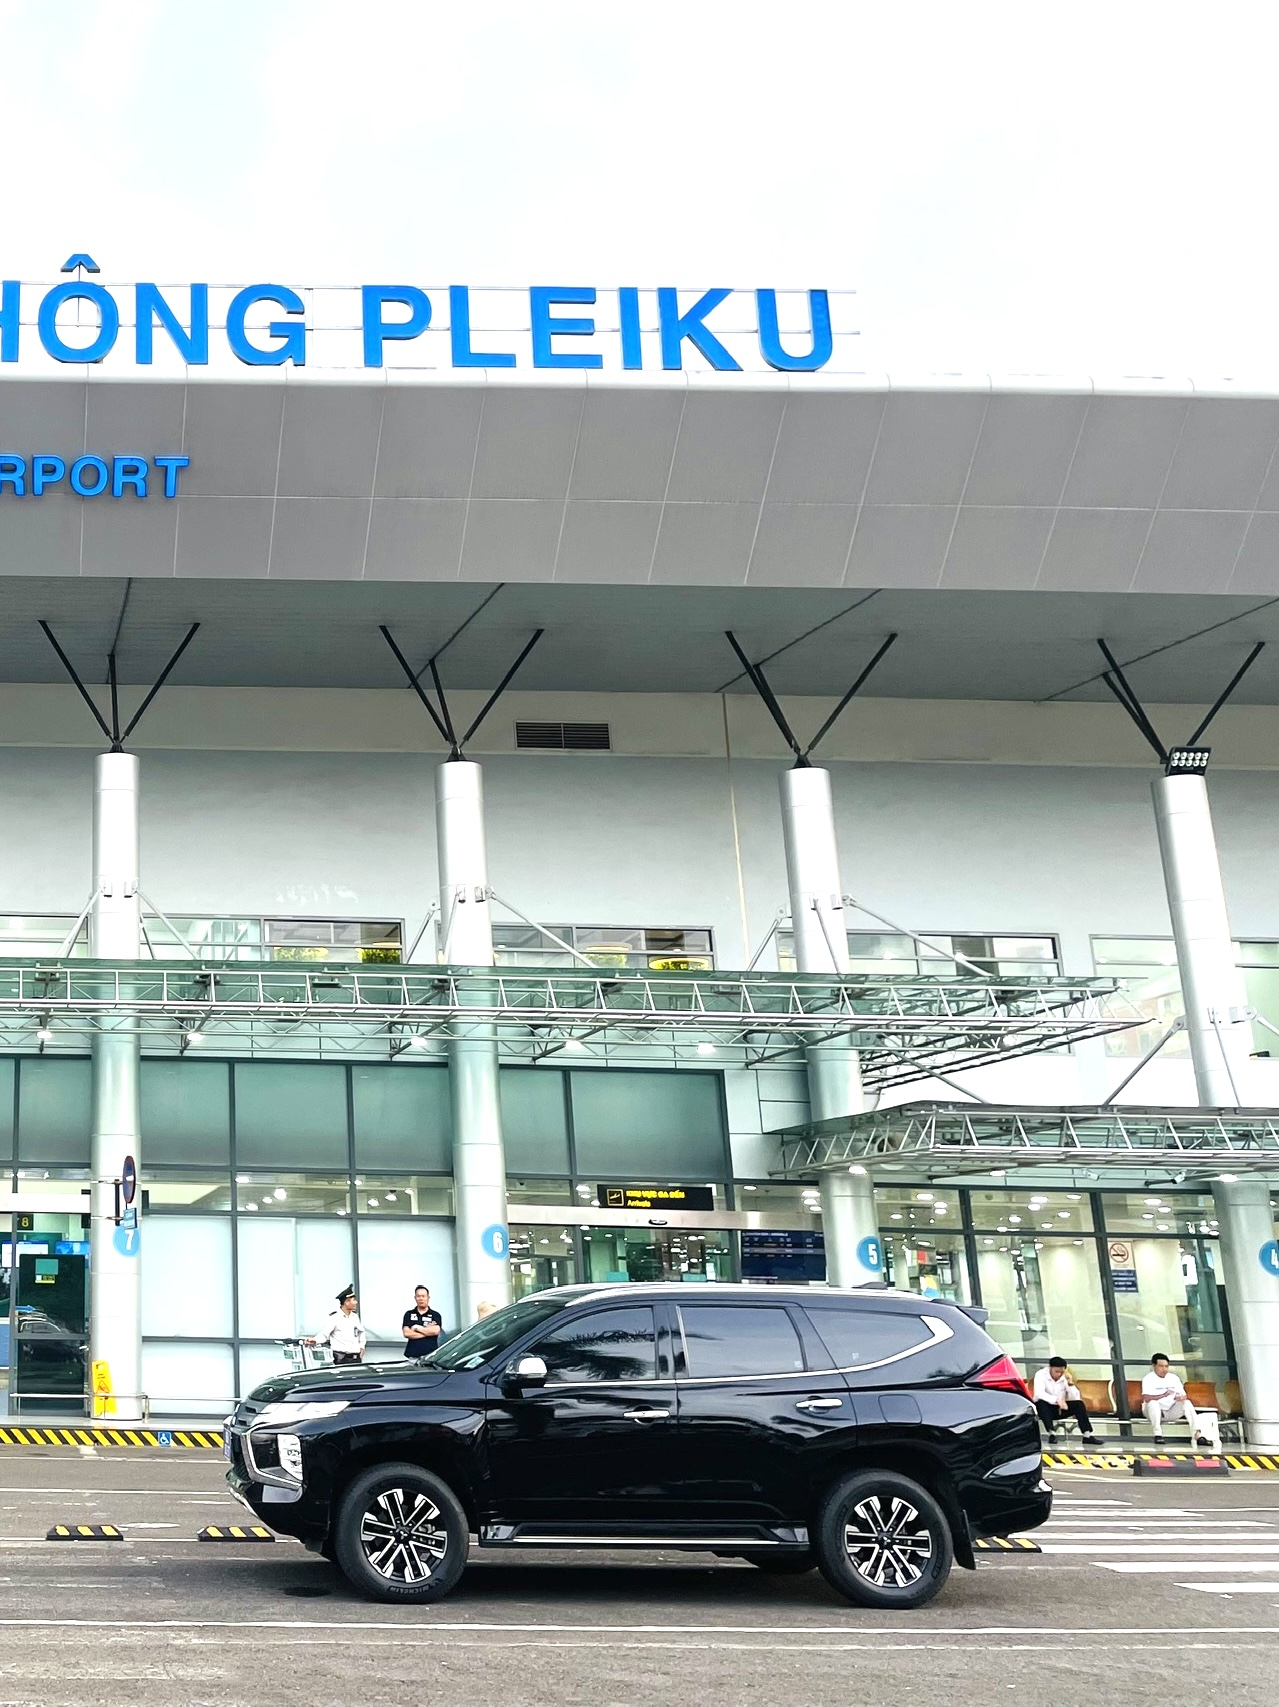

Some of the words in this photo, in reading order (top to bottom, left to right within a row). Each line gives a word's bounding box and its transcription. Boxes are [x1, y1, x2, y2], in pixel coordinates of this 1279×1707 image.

[361, 284, 833, 373] PLEIKU
[21, 1217, 29, 1227] 8
[124, 1229, 134, 1251] 7
[492, 1231, 504, 1254] 6
[867, 1243, 878, 1265] 5
